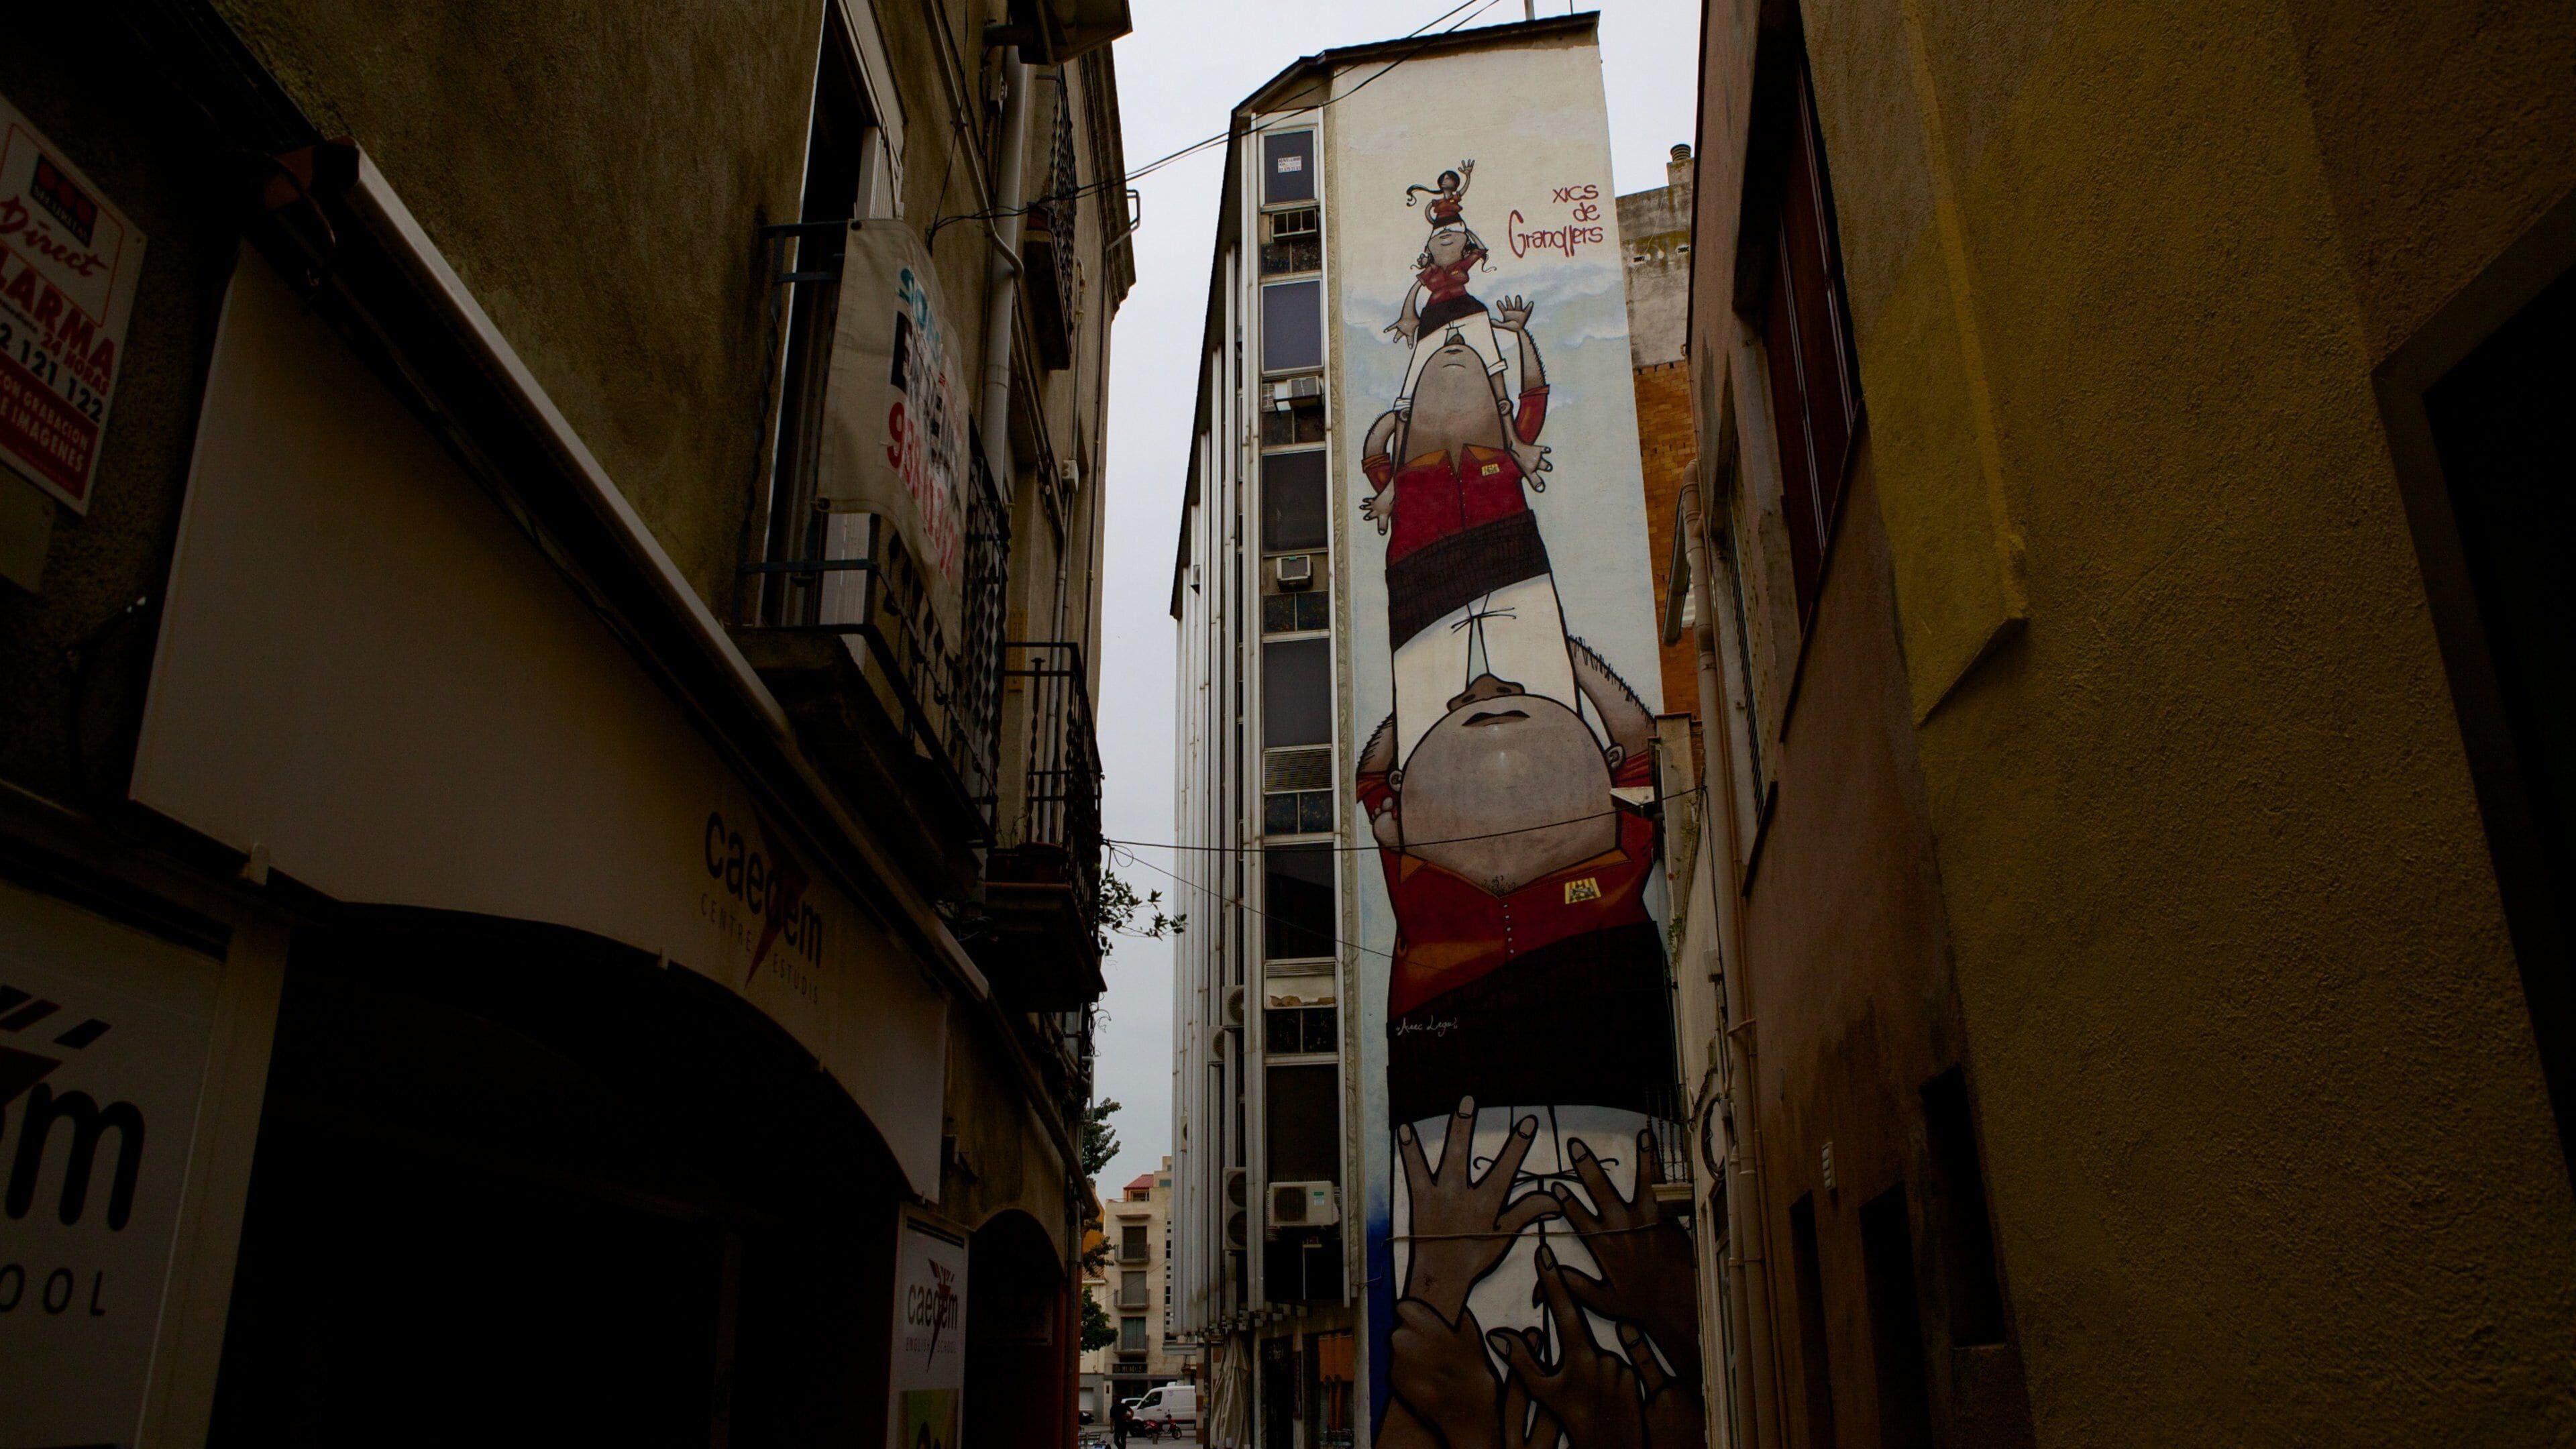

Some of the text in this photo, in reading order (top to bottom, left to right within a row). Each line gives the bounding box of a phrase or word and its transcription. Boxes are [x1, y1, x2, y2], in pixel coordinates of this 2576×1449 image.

[0, 195, 109, 277] Direct
[1572, 202, 1601, 222] de
[21, 339, 58, 386] 121
[68, 378, 103, 424] 122
[64, 349, 110, 396] HORAS
[11, 405, 85, 472] IMAGENES
[700, 893, 752, 952] CENTRE
[772, 953, 819, 1004] ESTUDIS
[906, 1336, 930, 1352] ENGLISH
